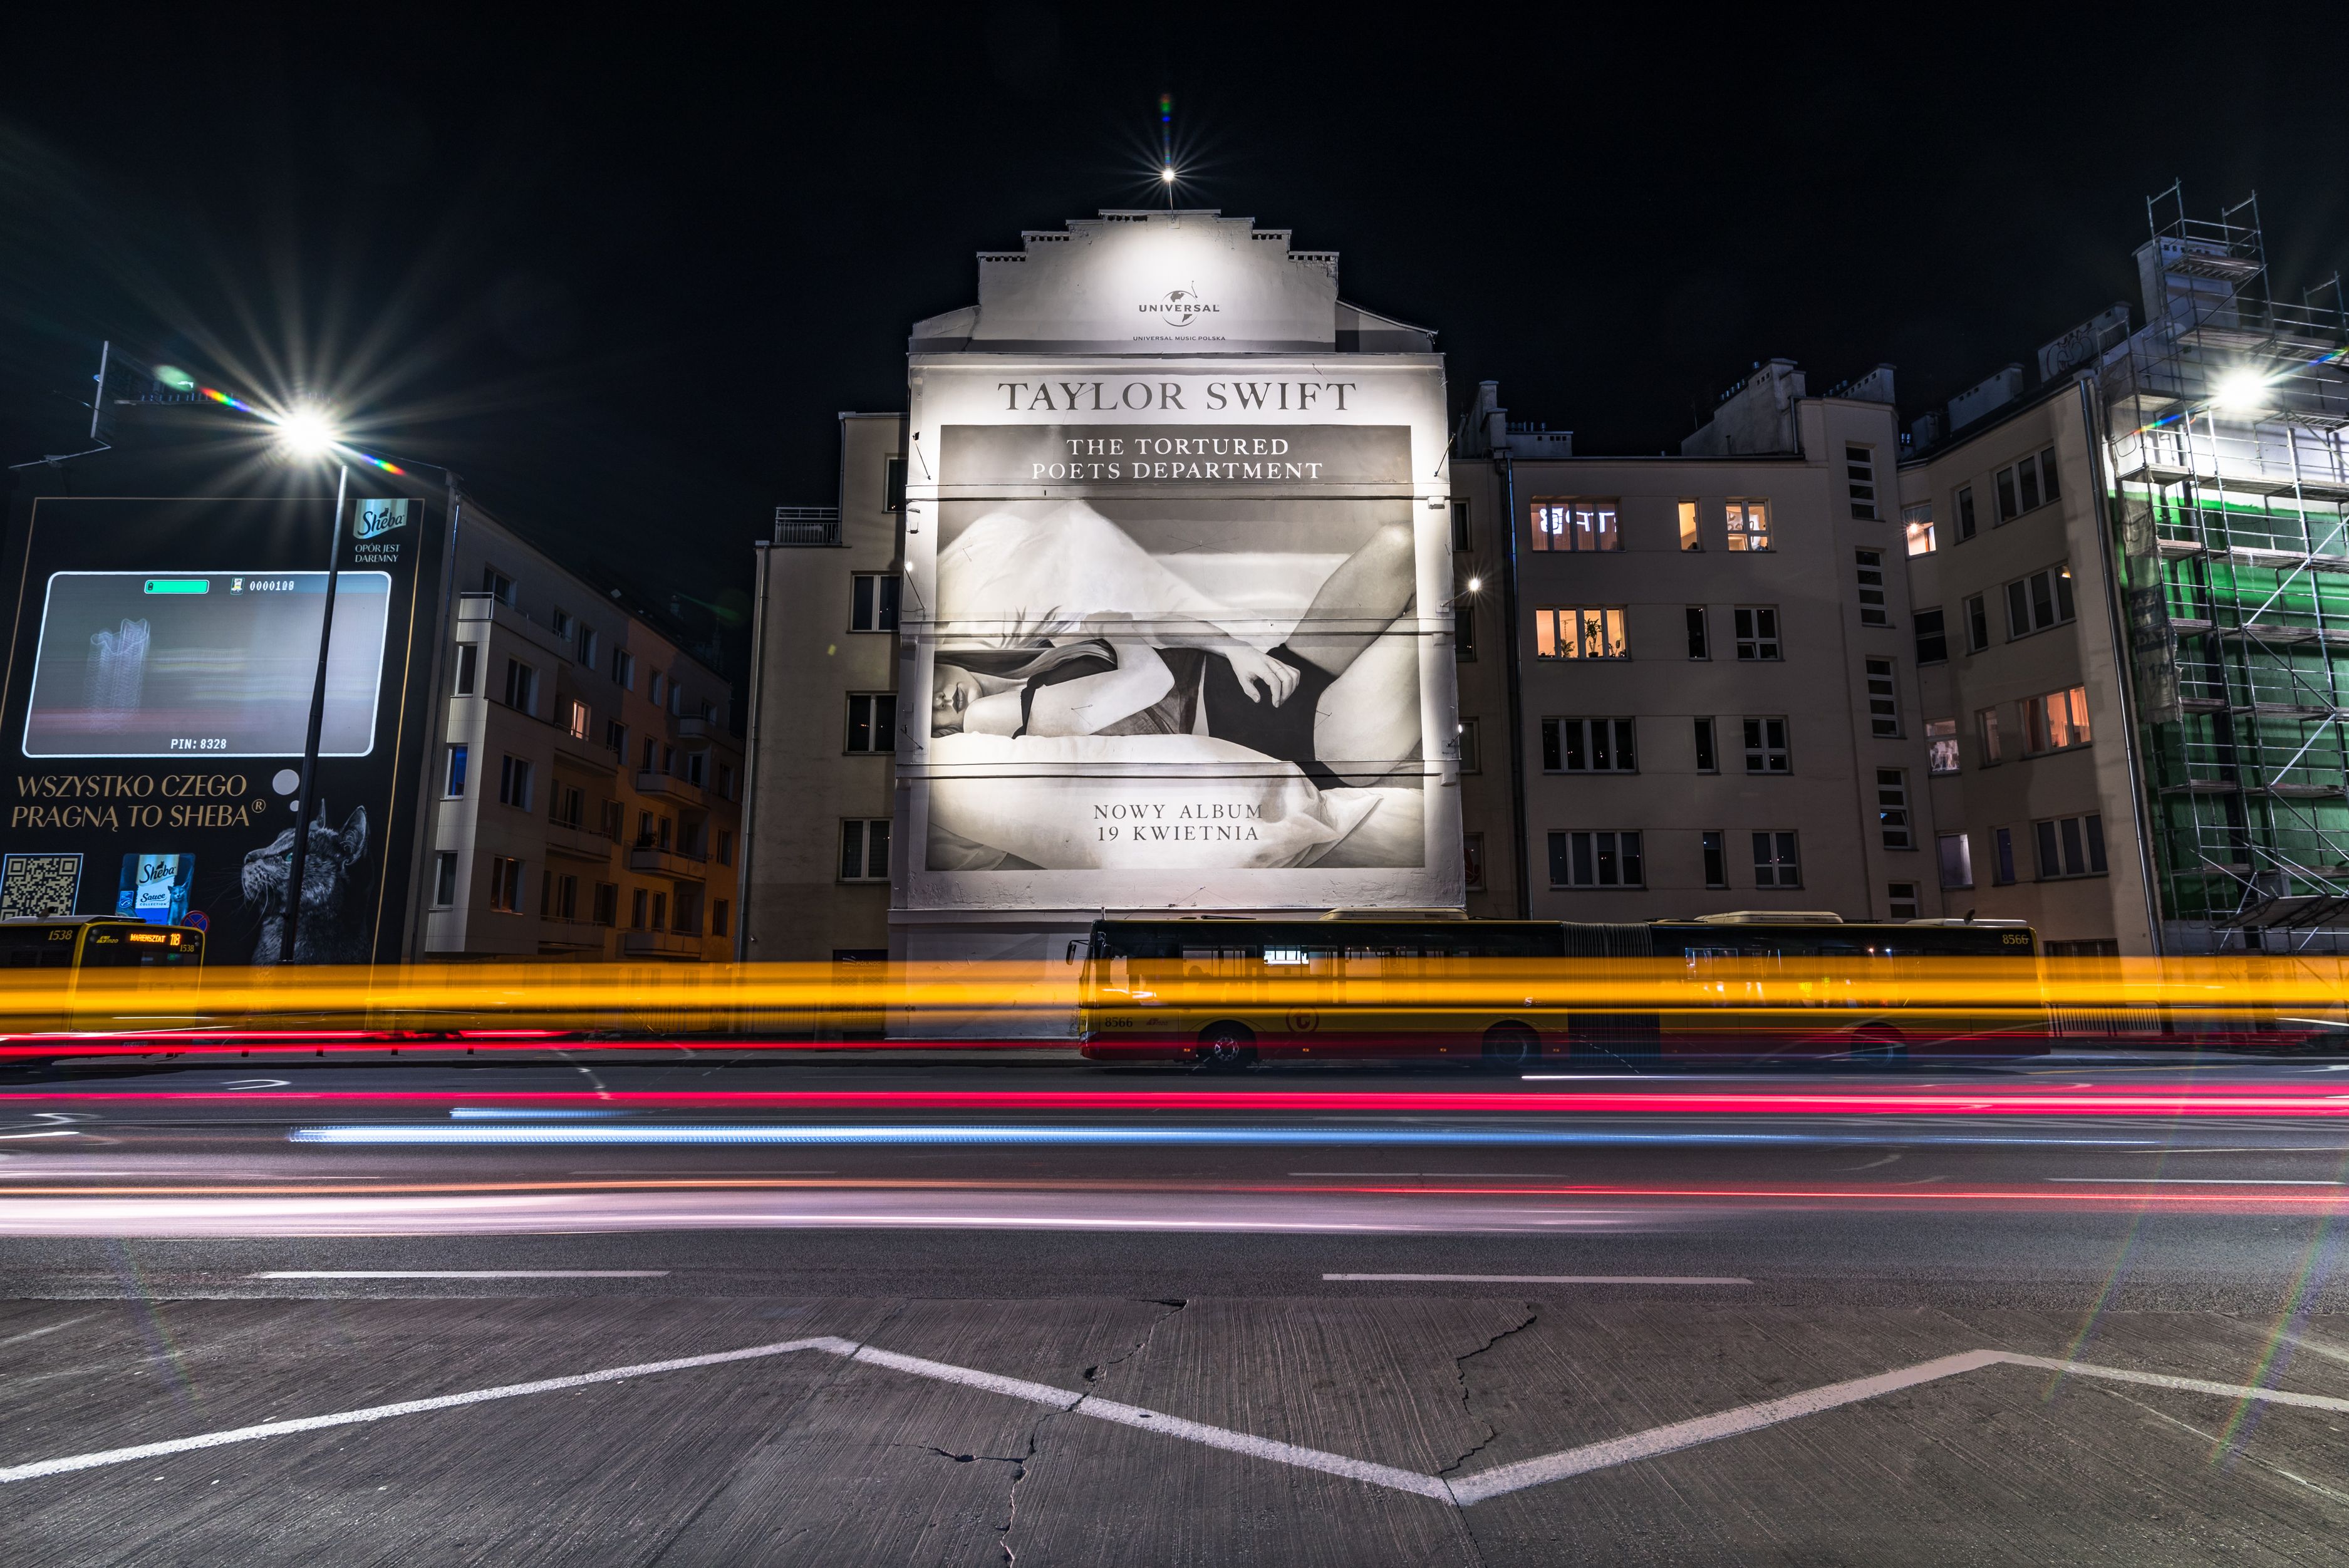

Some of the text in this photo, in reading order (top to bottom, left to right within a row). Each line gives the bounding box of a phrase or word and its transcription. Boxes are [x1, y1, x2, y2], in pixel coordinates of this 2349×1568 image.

[1138, 304, 1220, 312] UNIVERSAL
[997, 382, 1357, 410] TAYLOR SWIFT
[1066, 438, 1289, 455] THE TORTURED
[1032, 462, 1323, 480] POETS DEPARTMENT
[357, 511, 403, 536] Sheba
[355, 543, 401, 554] OPÓR JEST
[355, 554, 399, 563] DAREMNY
[170, 739, 227, 749] PIN: 8328
[17, 774, 247, 797] WSZYSTKO CZEGO
[1093, 804, 1263, 819] NOWY ALBUM
[11, 805, 120, 833] PRAGNĄ
[127, 804, 163, 828] TO
[1097, 826, 1260, 841] 19 KWIETNIA
[139, 863, 175, 884] Sheba
[140, 893, 166, 903] Sauce
[48, 930, 73, 940] 1538
[170, 933, 181, 946] 118
[2001, 934, 2030, 945] 8566
[180, 944, 195, 952] 1538
[1105, 1016, 1134, 1028] 8566
